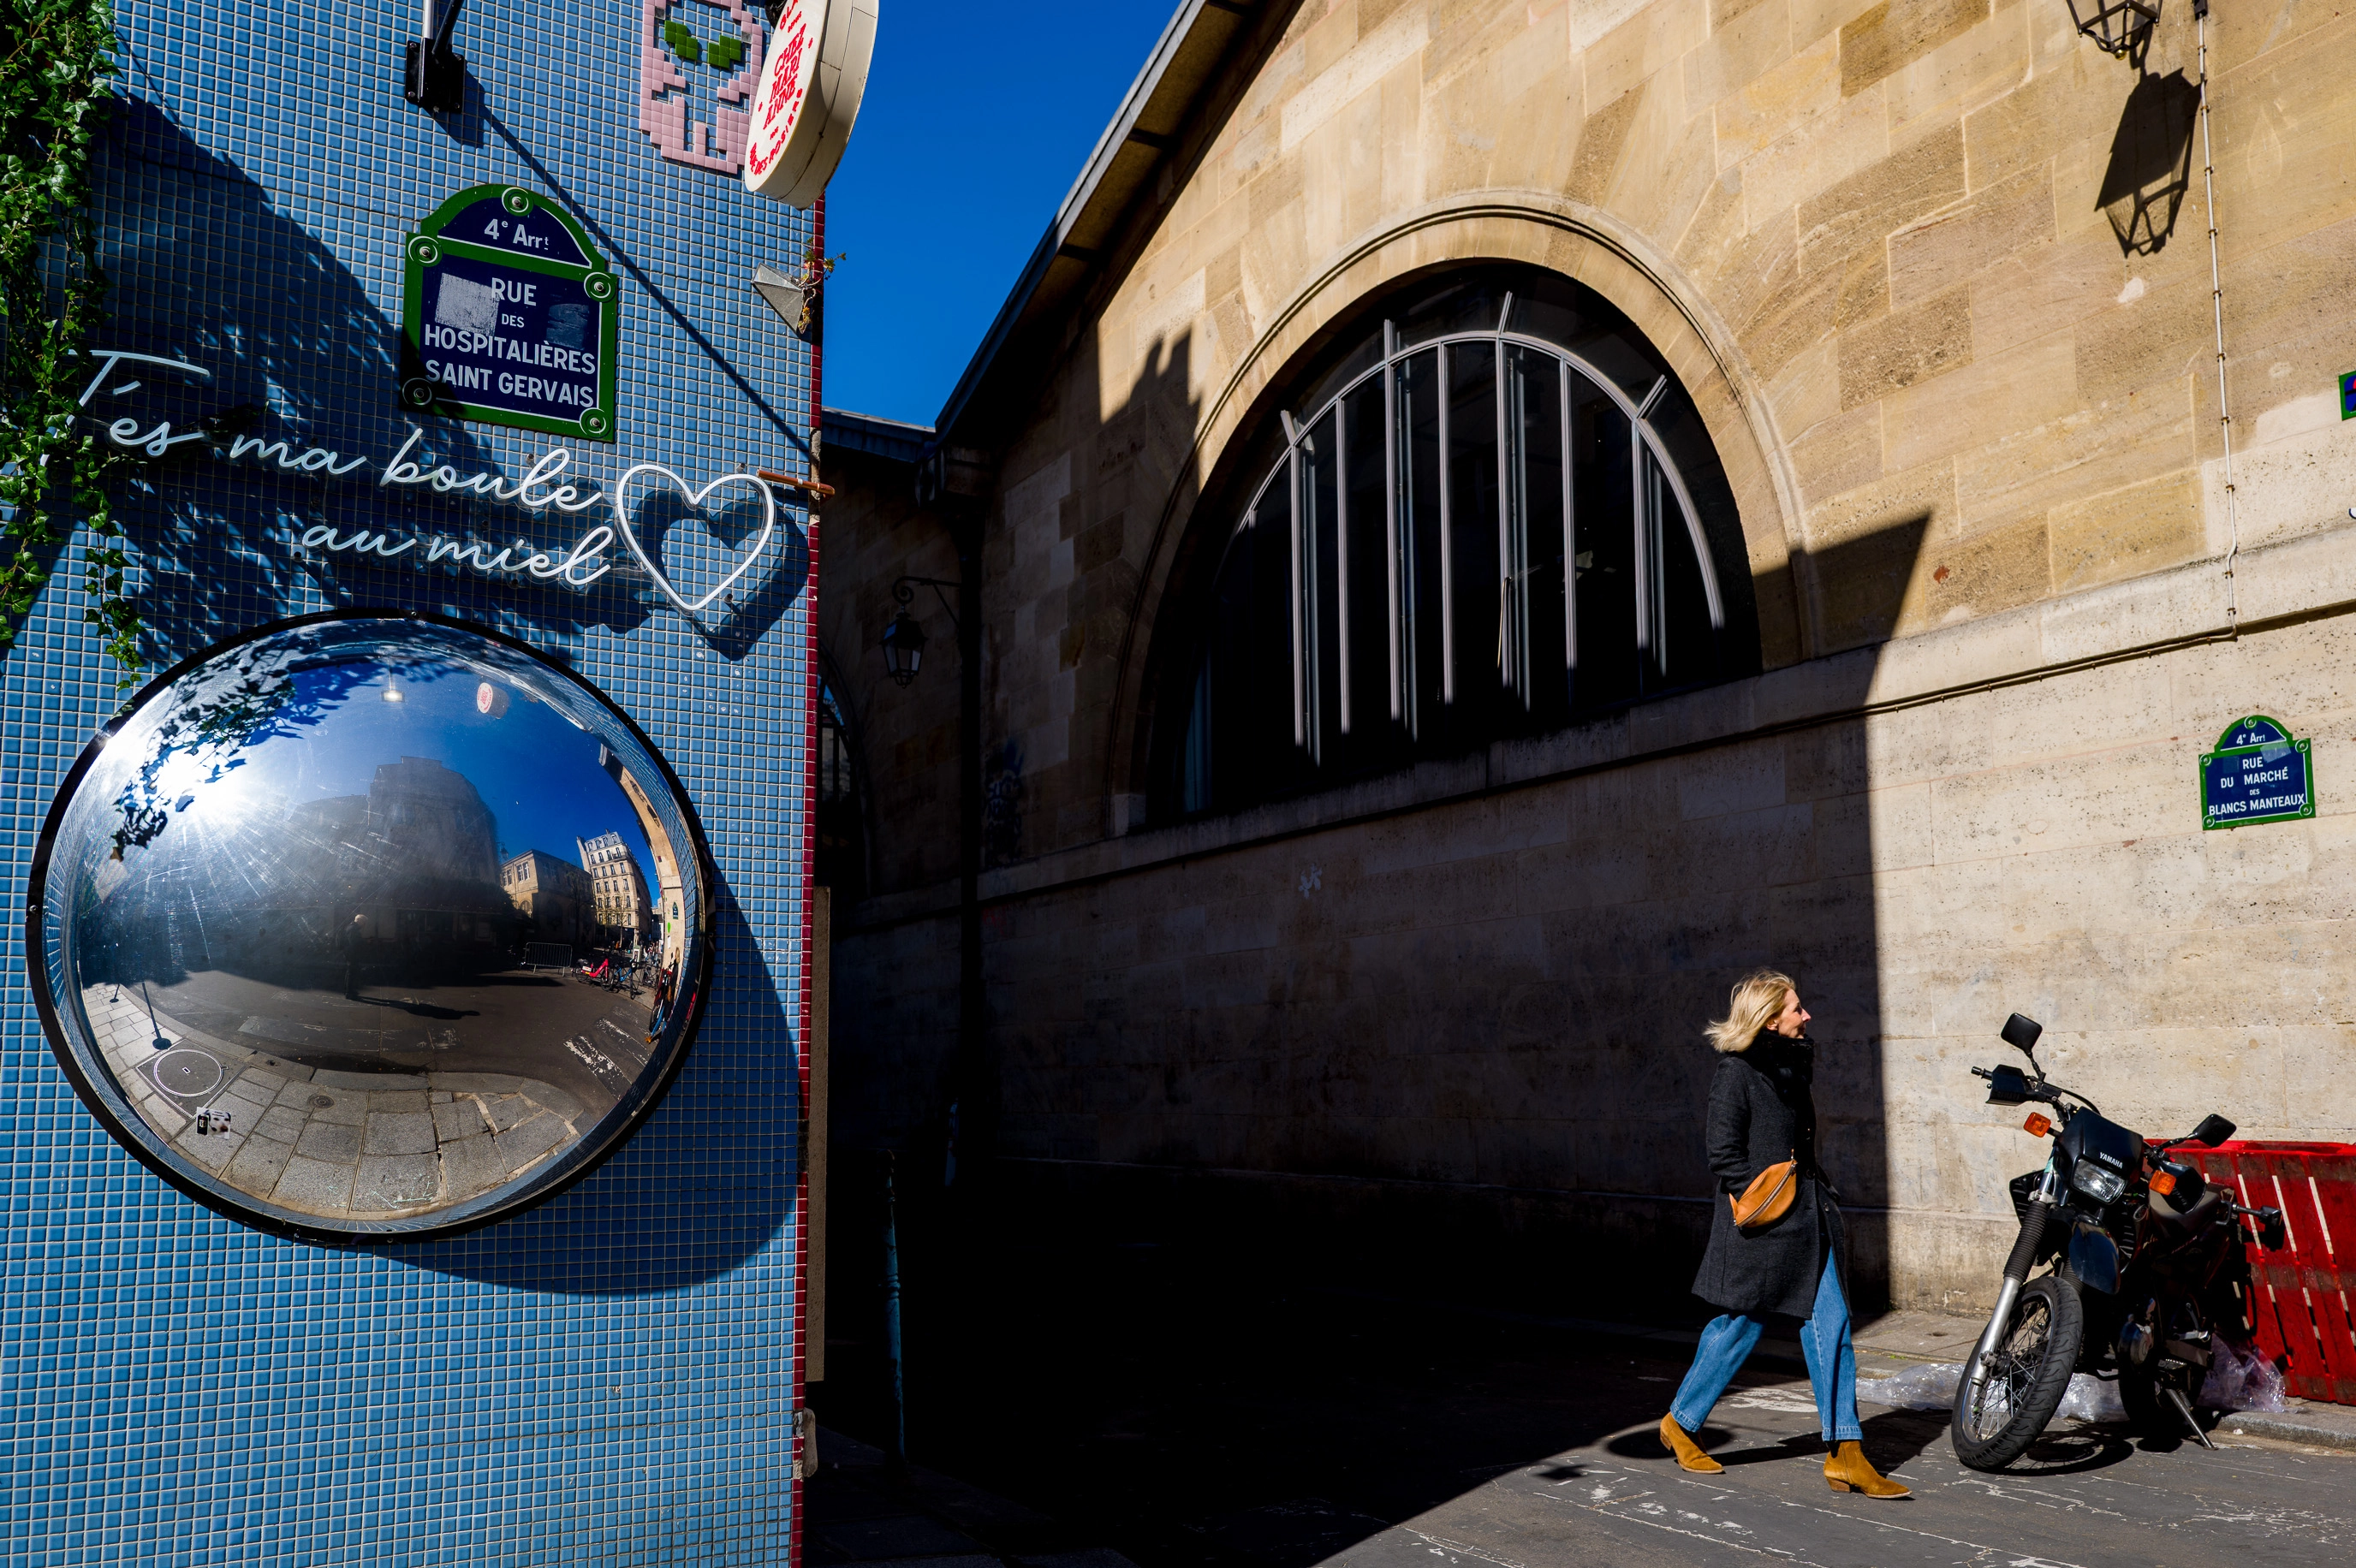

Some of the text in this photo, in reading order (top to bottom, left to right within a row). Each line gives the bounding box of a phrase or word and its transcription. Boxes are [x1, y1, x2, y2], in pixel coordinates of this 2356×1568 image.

[774, 23, 806, 75] CHEZ
[769, 48, 802, 103] MARI
[763, 74, 798, 130] ANNE
[491, 277, 537, 306] RUE
[501, 313, 525, 328] DES
[425, 324, 596, 375] HOSPITALIÈRES
[425, 359, 594, 407] SAINT GERVAIS
[229, 434, 367, 475] ma
[379, 428, 602, 511] boule
[301, 525, 614, 585] au miel
[2220, 766, 2288, 788] DU MARCHÉ
[2242, 757, 2264, 769] RUE
[2209, 793, 2305, 816] BLANCS MANTEAUX
[2099, 1152, 2123, 1169] YAMAHA
